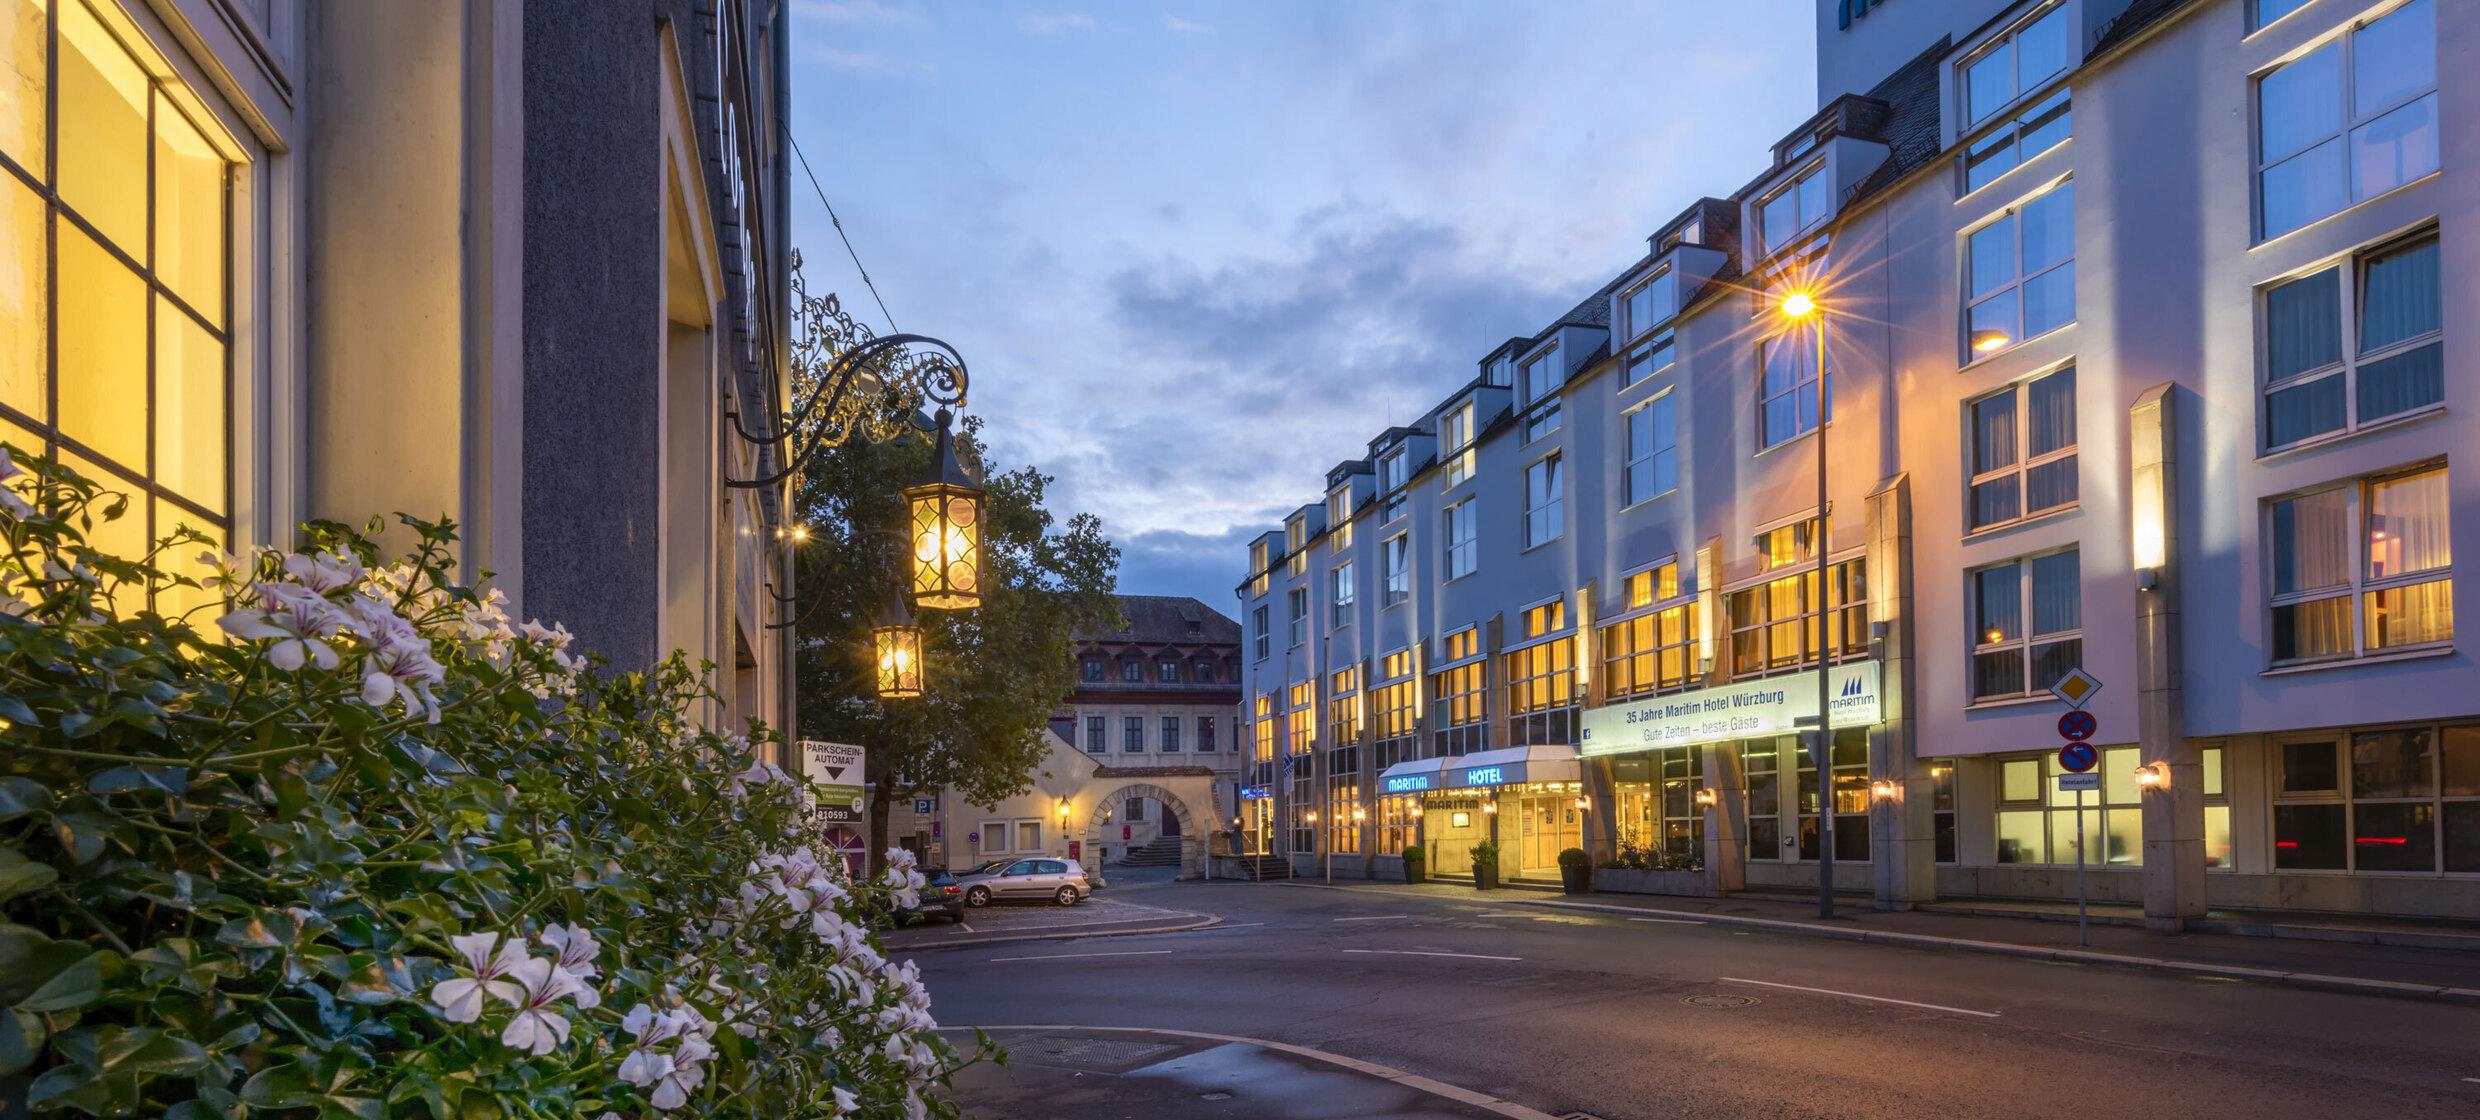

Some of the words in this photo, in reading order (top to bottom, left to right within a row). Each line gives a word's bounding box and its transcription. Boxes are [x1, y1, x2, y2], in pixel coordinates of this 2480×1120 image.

[1626, 711, 1637, 724] 35
[1639, 708, 1663, 722] Jahre
[1665, 703, 1701, 718] Maritim
[1703, 696, 1729, 712] Hotel
[1732, 690, 1785, 707] Würzburg
[1829, 694, 1875, 709] MARITIM
[1643, 728, 1663, 742] Gute
[1665, 724, 1691, 739] Zeiten
[1702, 719, 1727, 734] beste
[1730, 716, 1759, 730] Gäste
[806, 743, 863, 756] PARKSCHEIN-
[814, 754, 855, 765] AUTOMAT
[1388, 776, 1428, 792] MARITIM
[1468, 768, 1503, 785] HOTEL
[918, 801, 928, 813] P
[1426, 799, 1479, 810] MARITIM
